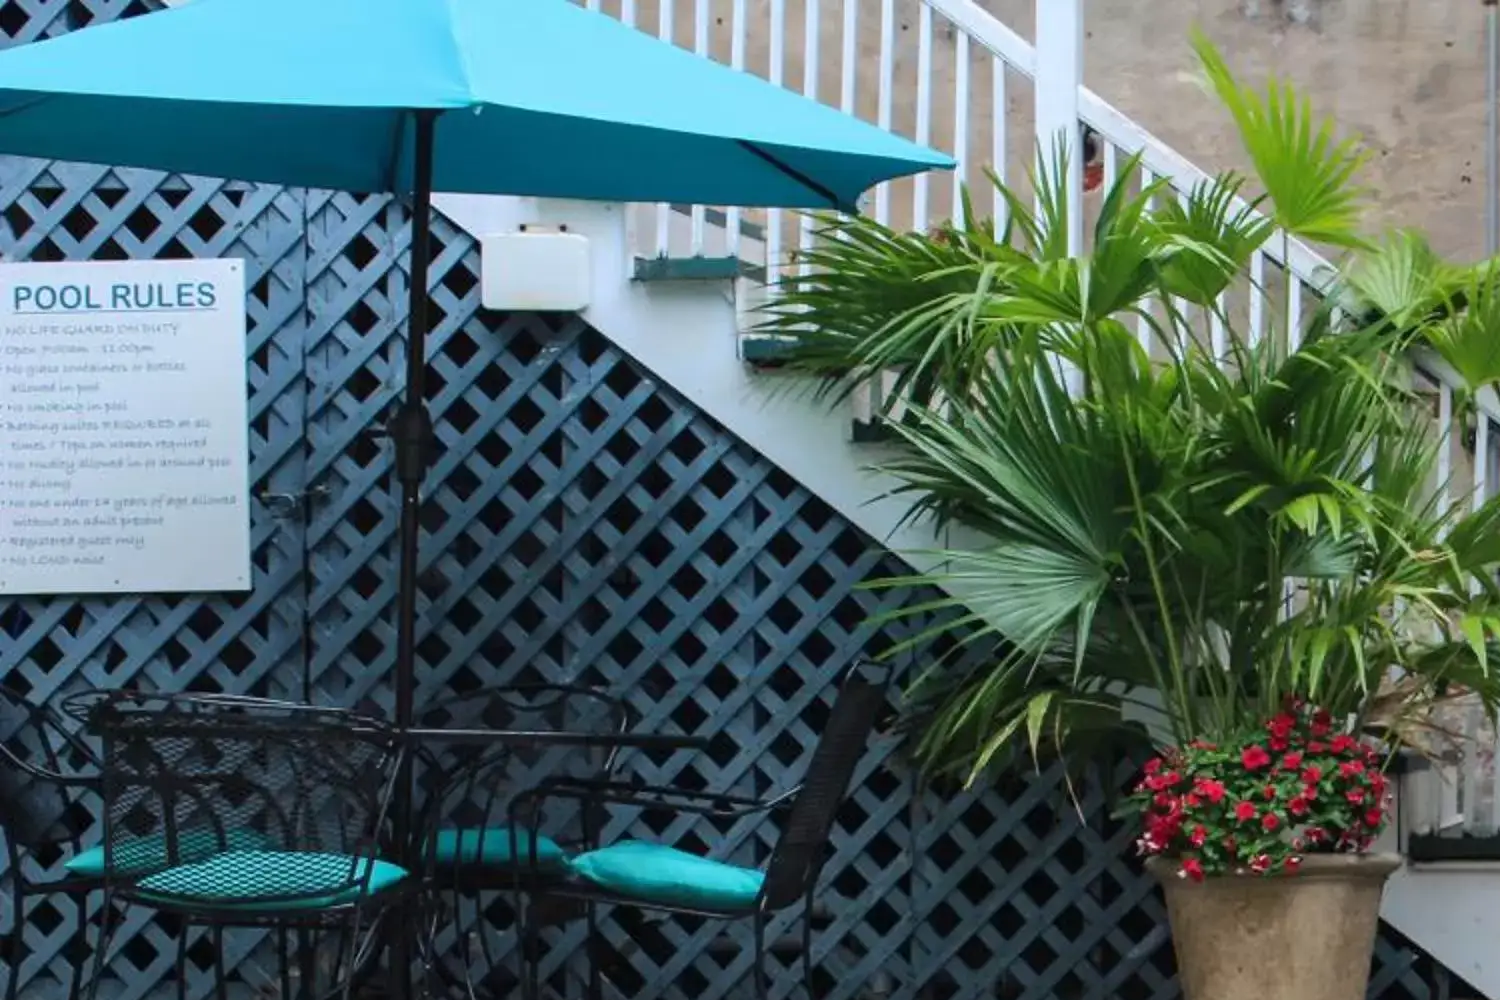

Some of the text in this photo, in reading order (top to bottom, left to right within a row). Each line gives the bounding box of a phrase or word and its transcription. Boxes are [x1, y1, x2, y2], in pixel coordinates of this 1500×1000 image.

[13, 282, 216, 310] POOL RULES
[5, 322, 180, 336] NO LIFE GUARD ON DUTY
[5, 345, 36, 358] Open
[5, 360, 186, 378] No glass containers or bottles
[11, 378, 100, 399] allowed in pool
[7, 399, 127, 415] No smoking in pool
[6, 420, 59, 435] Bathing
[11, 439, 46, 450] times
[109, 440, 152, 449] women
[155, 436, 207, 453] required
[8, 461, 25, 469] No
[29, 459, 76, 475] nudity
[79, 456, 123, 469] allowed
[159, 456, 205, 468] around
[53, 496, 89, 508] under
[113, 497, 147, 512] years
[151, 493, 165, 512] of
[166, 496, 188, 510] age
[191, 494, 236, 506] allowed
[13, 515, 164, 530] without an adult present
[10, 536, 74, 550] Registered
[115, 535, 145, 550] only
[31, 555, 70, 565] LOUD
